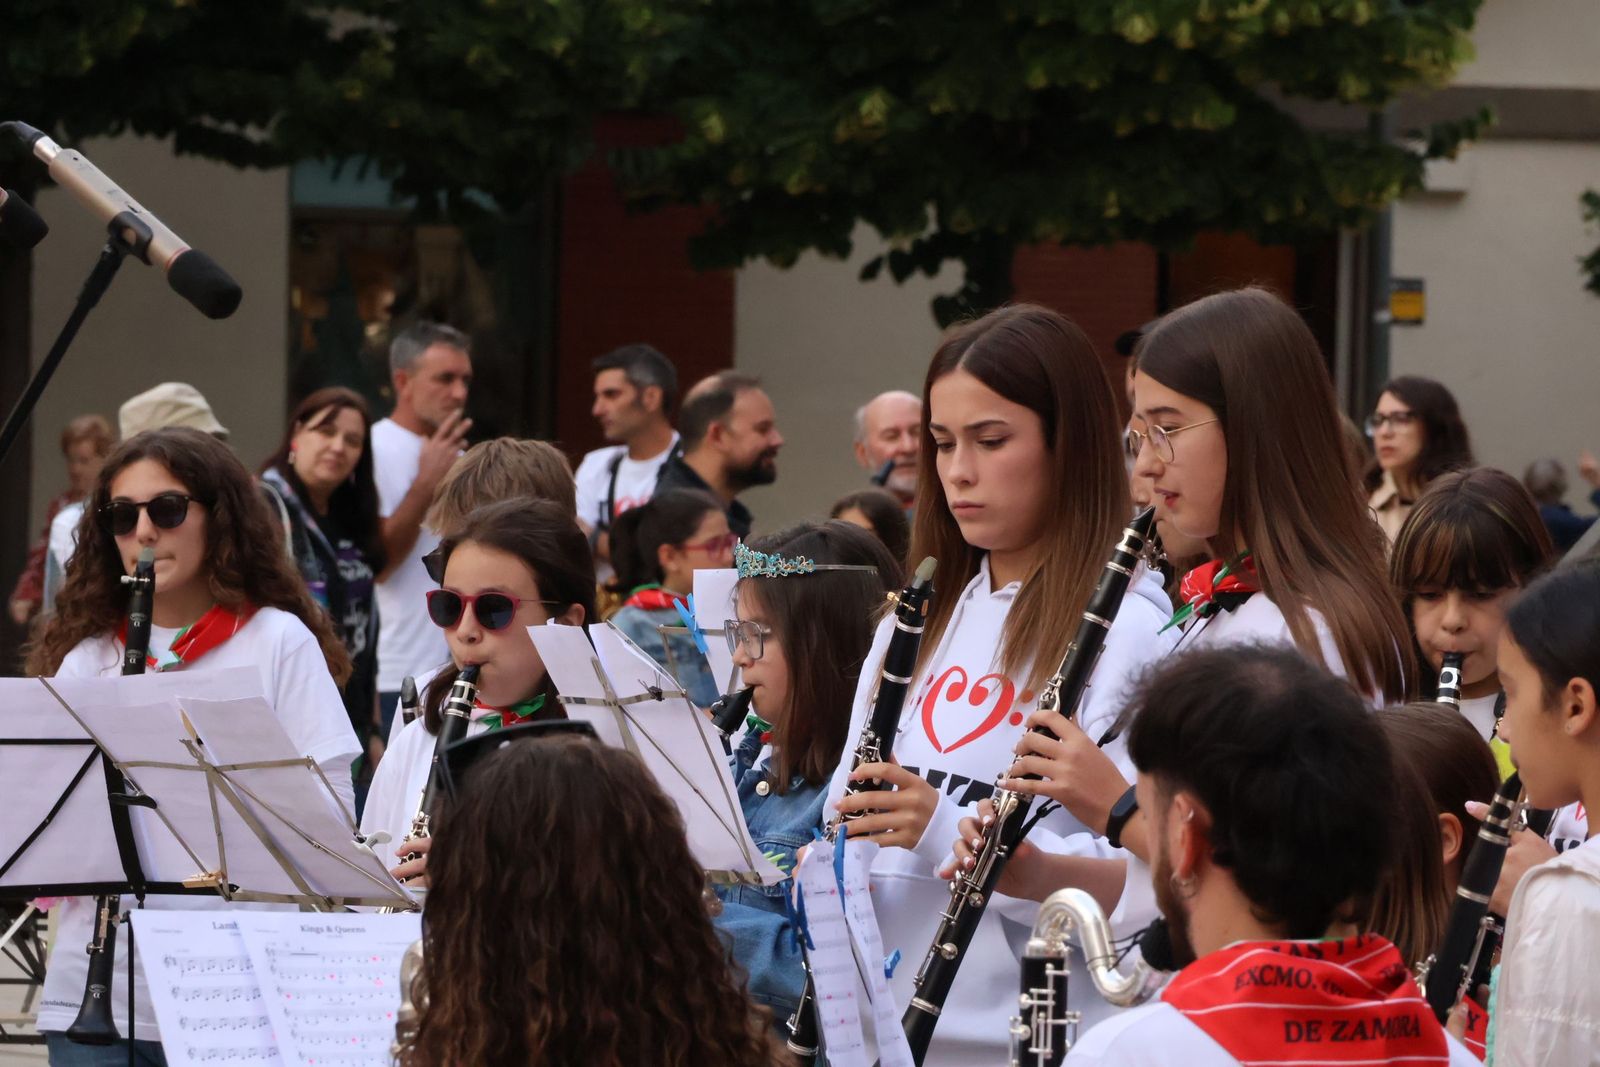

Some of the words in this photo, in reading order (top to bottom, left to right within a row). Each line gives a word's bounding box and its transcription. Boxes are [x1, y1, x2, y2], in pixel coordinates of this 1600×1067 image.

[300, 925, 324, 934] Kings
[327, 925, 333, 933] &
[335, 925, 366, 934] Queens
[1235, 964, 1317, 991] EXCMO.
[1284, 1019, 1322, 1043] DE
[1330, 1014, 1421, 1042] ZAMORA
